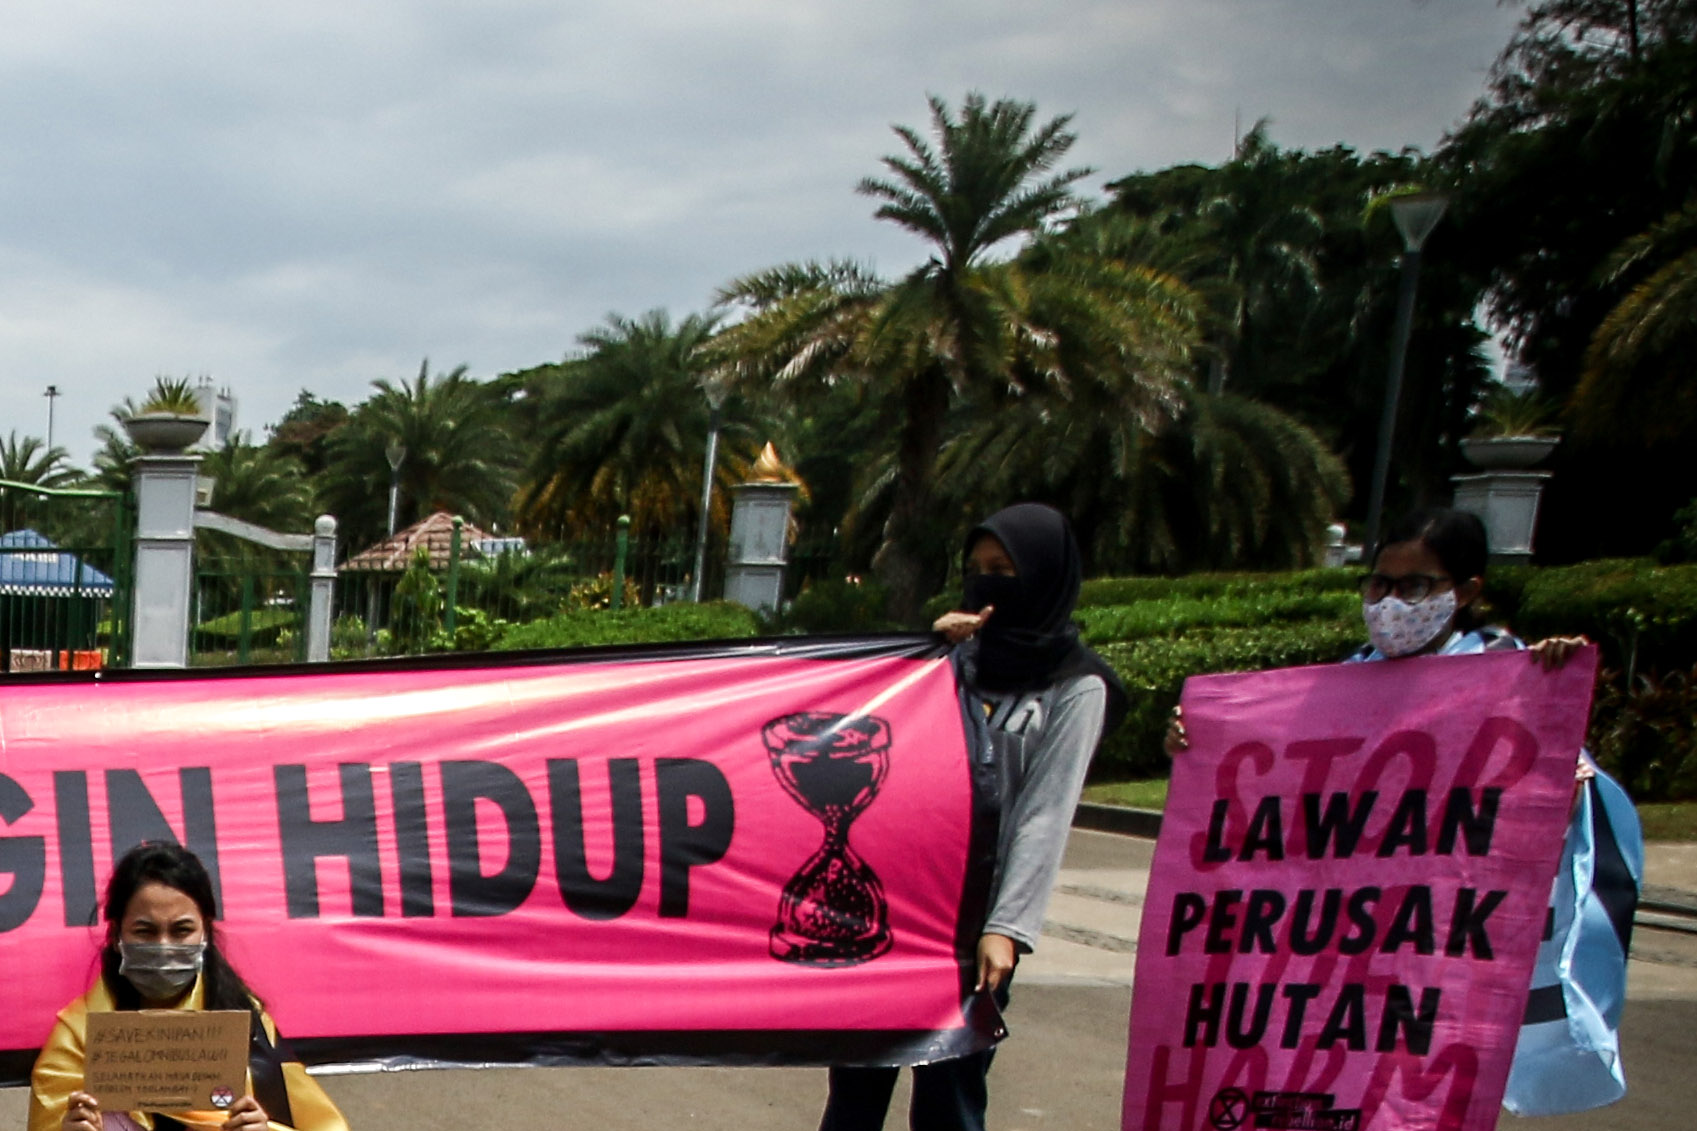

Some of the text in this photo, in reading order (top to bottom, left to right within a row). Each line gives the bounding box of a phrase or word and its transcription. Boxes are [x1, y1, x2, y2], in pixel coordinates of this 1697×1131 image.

[272, 756, 735, 921] HIDUP
[1201, 787, 1503, 863] LAWAN
[1166, 883, 1509, 960] PERUSAK
[1182, 983, 1441, 1056] HUTAN
